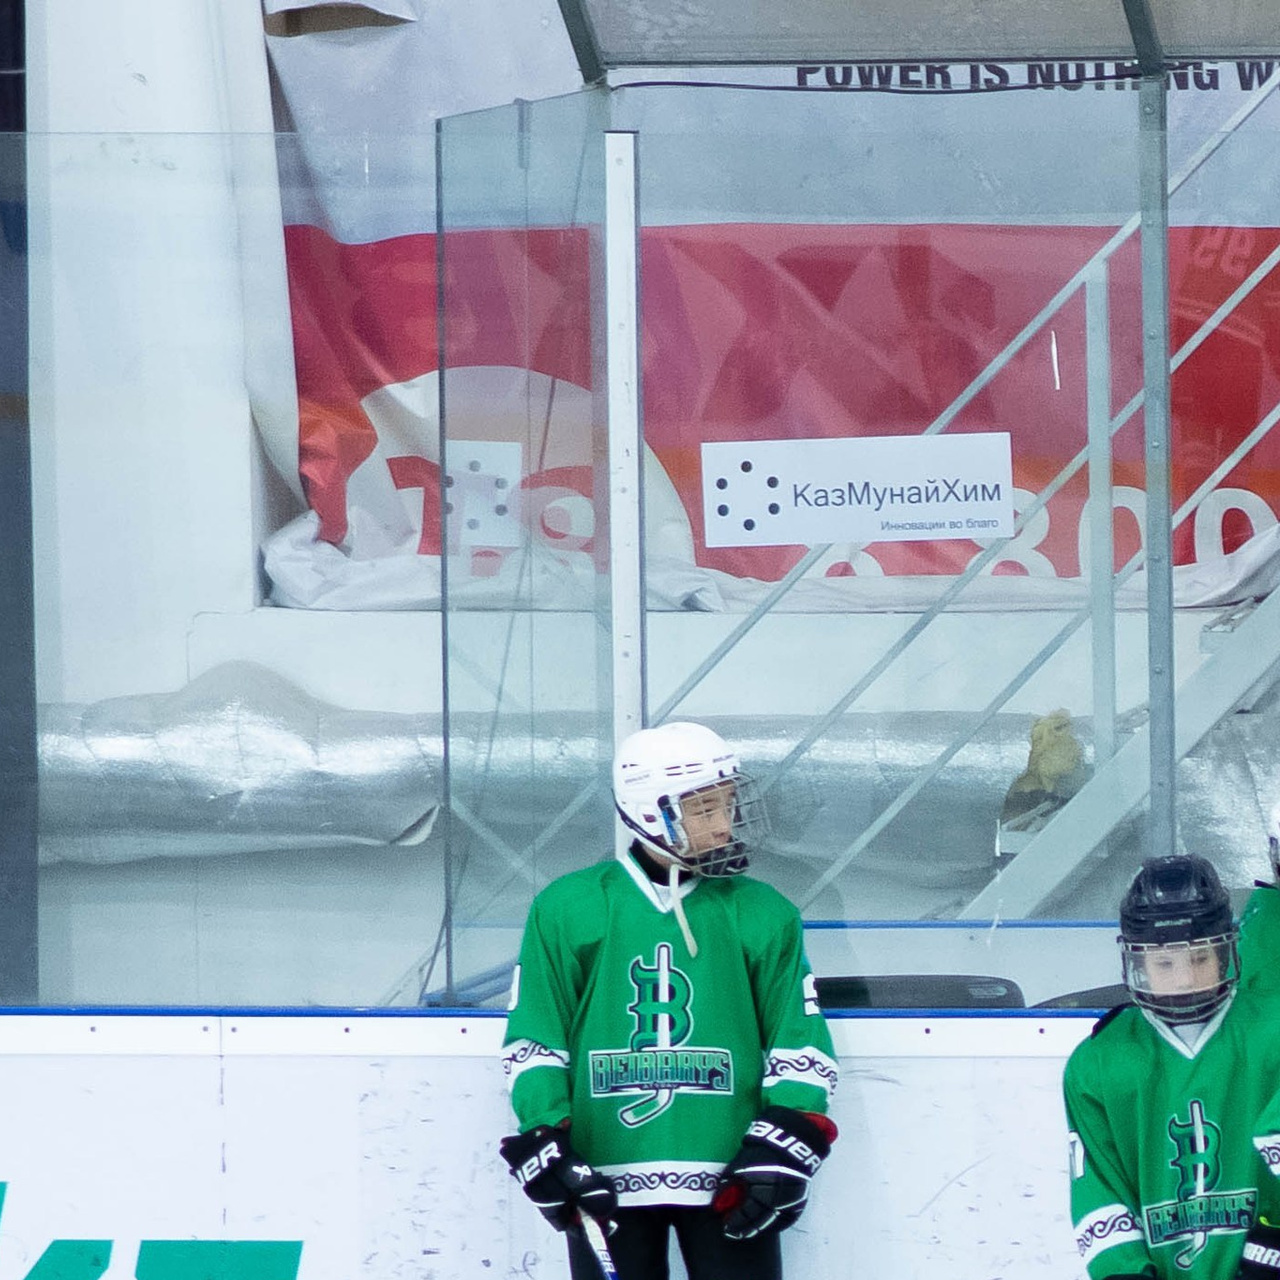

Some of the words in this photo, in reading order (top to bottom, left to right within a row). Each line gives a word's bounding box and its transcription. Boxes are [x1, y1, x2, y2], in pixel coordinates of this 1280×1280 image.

[796, 64, 952, 91] POWER
[969, 64, 1010, 91] IS
[1027, 62, 1220, 91] NOTHNG
[792, 479, 1002, 512] КазМунайХим
[949, 519, 963, 530] во
[966, 517, 999, 529] благо
